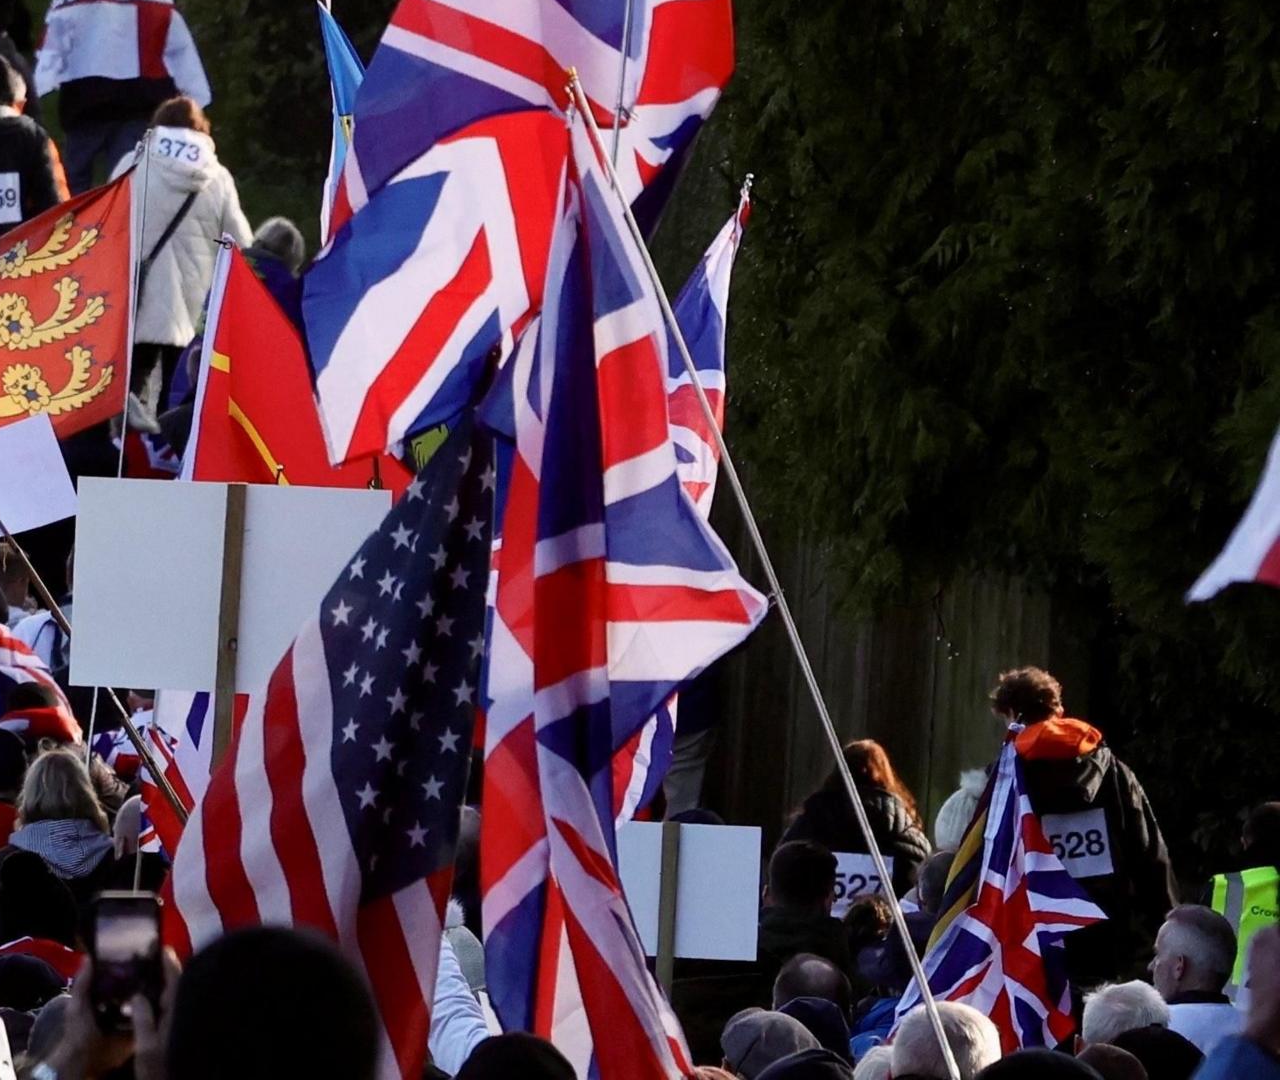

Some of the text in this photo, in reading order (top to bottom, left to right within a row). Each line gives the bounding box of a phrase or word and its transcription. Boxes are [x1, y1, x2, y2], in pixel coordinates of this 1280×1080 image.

[158, 137, 201, 163] 373
[1050, 829, 1105, 860] 528
[833, 874, 883, 904] 527
